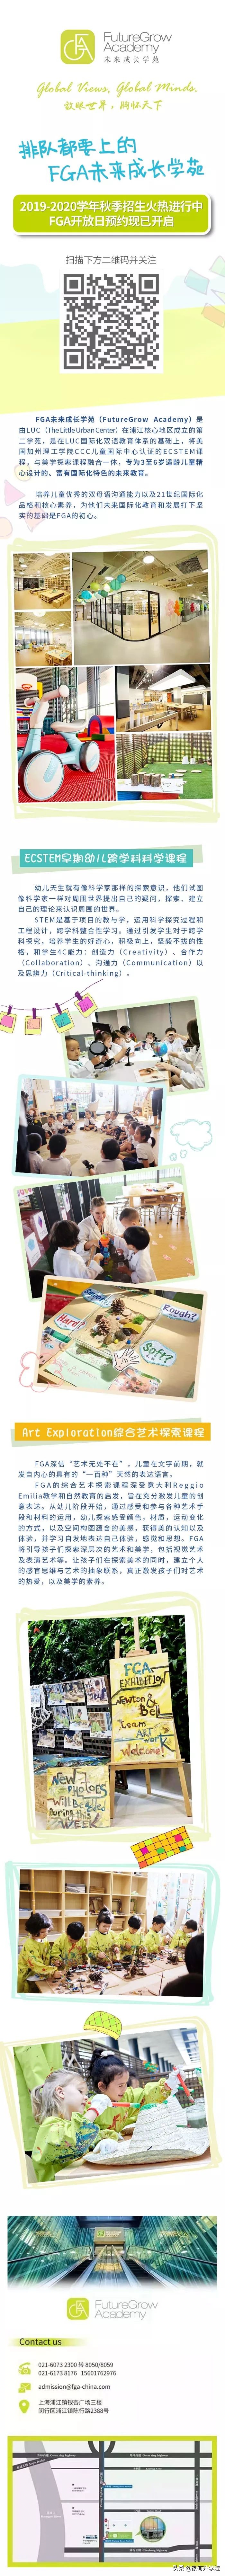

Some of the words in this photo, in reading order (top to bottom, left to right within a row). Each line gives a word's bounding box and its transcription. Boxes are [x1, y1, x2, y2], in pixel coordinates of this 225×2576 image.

[104, 32, 172, 42] FutureGrow
[104, 42, 159, 54] Academy
[37, 82, 73, 98] Global
[77, 82, 111, 94] Views,
[116, 82, 152, 98] Global
[155, 82, 197, 93] Minds.
[64, 100, 163, 111] 放眼世界，胸怀天下
[19, 136, 137, 159] 排队都要上的
[48, 157, 205, 183] FGA未来成长学苑
[20, 201, 203, 212] 2019-2020学年秋季招生火热进行中
[49, 215, 174, 227] FGA开放日预约现已开启
[66, 255, 157, 265] 扫描下方二维码并关注
[25, 853, 187, 864] ECSTEM早期幼儿跨学科科学课程
[162, 1304, 197, 1320] Rough?
[143, 1342, 173, 1363] Soft?
[22, 1427, 40, 1437] Art
[47, 1427, 205, 1439] Exploration综合艺术探索课程
[35, 1482, 203, 1490] FGA的综合艺术探索课程深受意大利Reggio
[124, 1662, 151, 1676] FGA
[120, 1672, 167, 1688] EXHIBITION
[146, 1693, 158, 1708] &
[136, 1727, 153, 1738] ART
[58, 1813, 99, 1829] WEEK
[95, 2300, 158, 2309] FutureGrow
[94, 2309, 147, 2320] Academy
